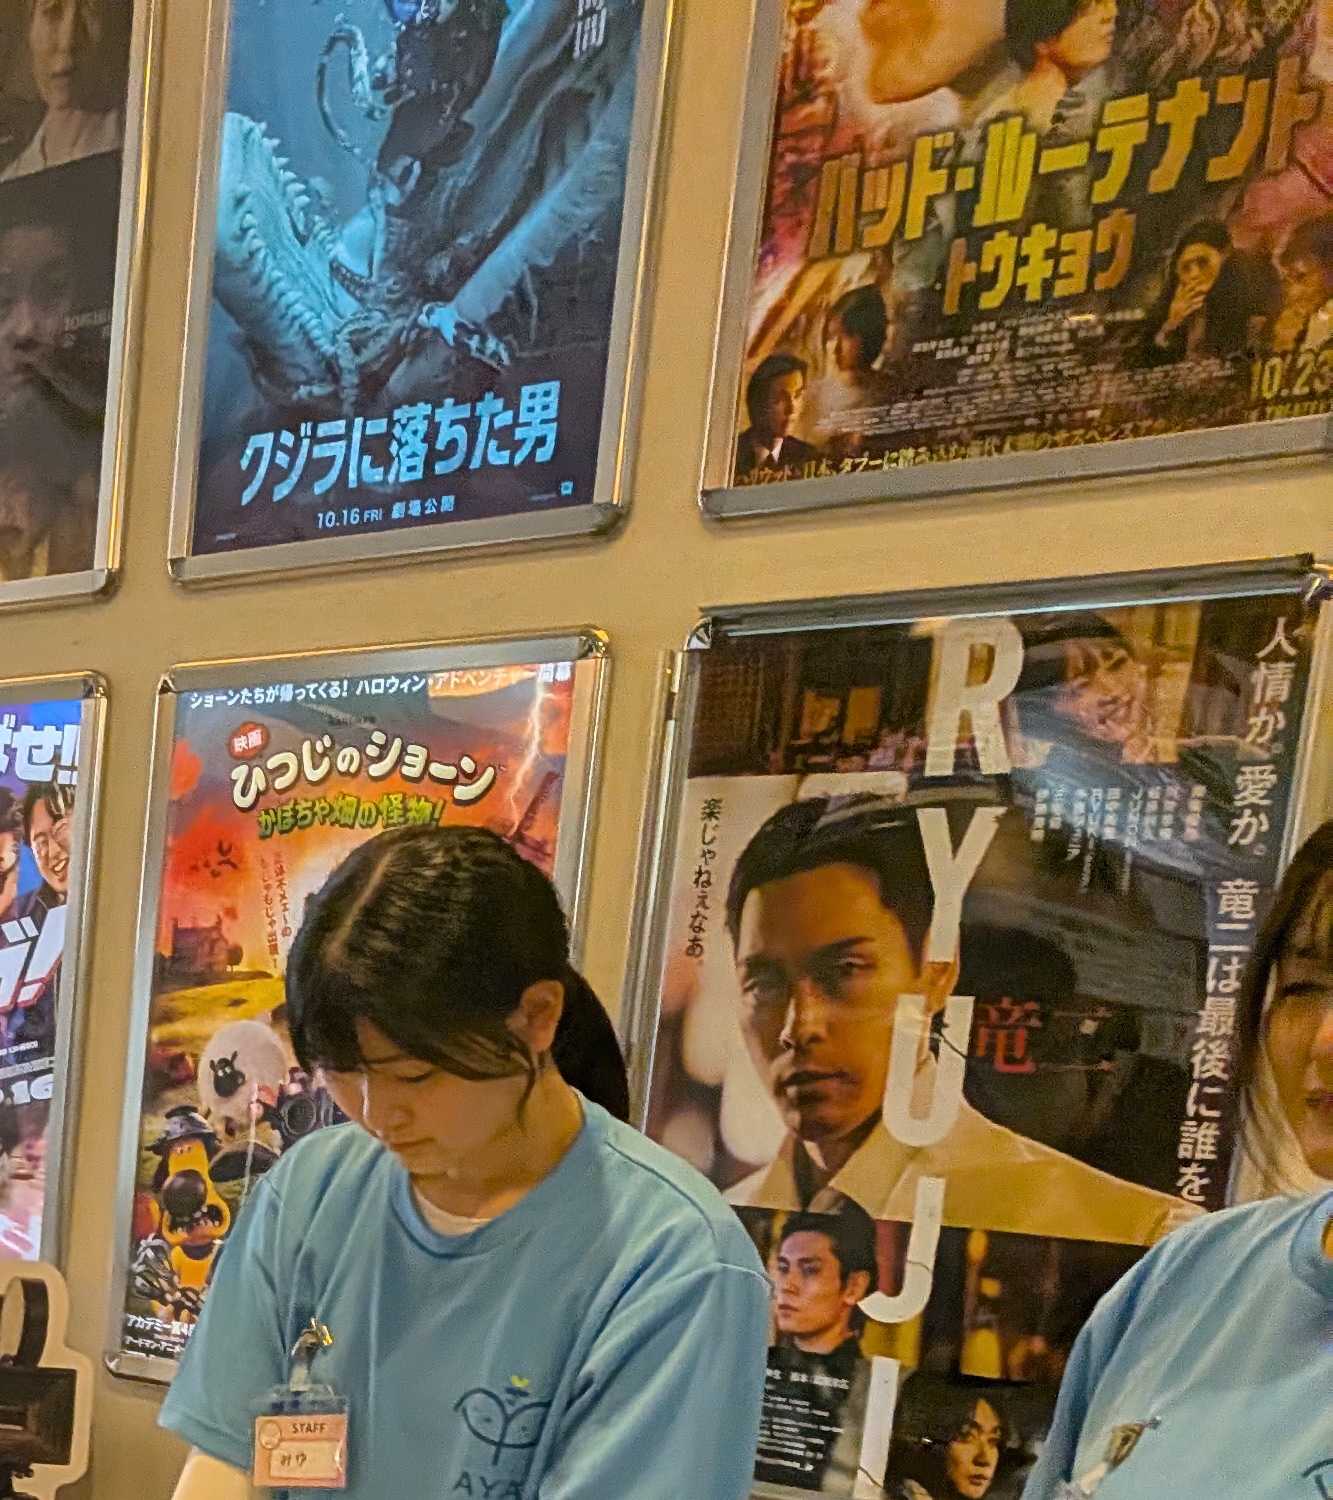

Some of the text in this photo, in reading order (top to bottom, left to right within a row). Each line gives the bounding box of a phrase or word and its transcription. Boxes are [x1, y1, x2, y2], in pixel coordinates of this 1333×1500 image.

[944, 208, 1137, 316] トウキョウ
[239, 380, 562, 506] クジラに落ちた男
[317, 507, 361, 530] 10.16
[363, 508, 383, 522] FRI
[230, 730, 496, 809] ひつじのショーン
[233, 727, 264, 754] 映画
[972, 997, 1042, 1074] 竜
[291, 1421, 327, 1435] STAFF
